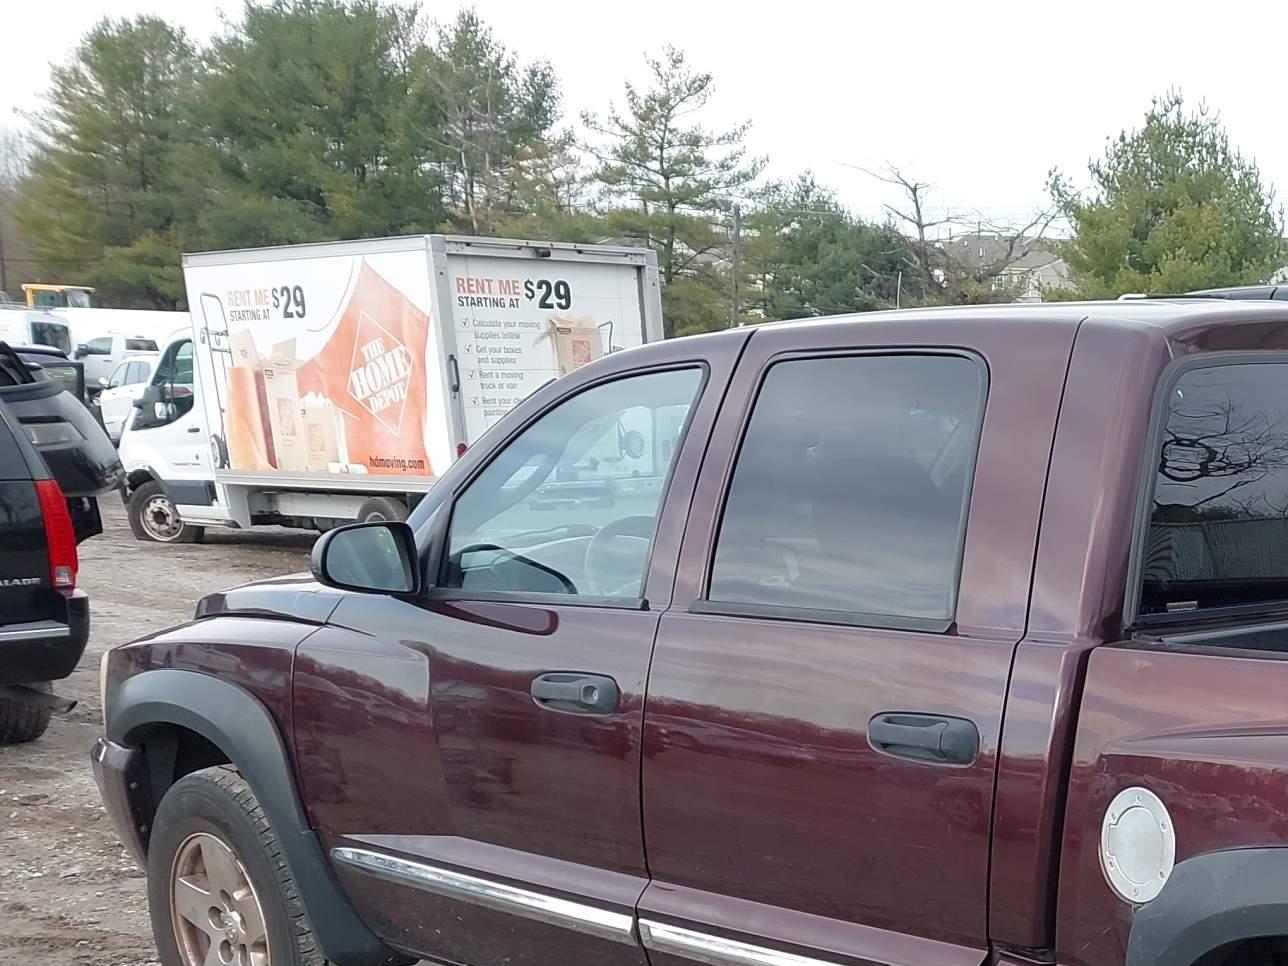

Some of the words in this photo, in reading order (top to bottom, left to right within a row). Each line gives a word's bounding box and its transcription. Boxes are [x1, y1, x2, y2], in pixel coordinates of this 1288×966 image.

[456, 277, 493, 295] RENT
[499, 279, 521, 296] ME
[524, 278, 571, 310] $29
[227, 290, 251, 306] RENT
[254, 289, 270, 305] ME
[271, 285, 306, 318] $29
[458, 296, 505, 309] STARTING
[509, 297, 520, 309] AT
[230, 309, 261, 322] STARTING
[263, 309, 270, 320] AT
[472, 319, 502, 328] Calculate
[503, 321, 517, 329] your
[518, 321, 541, 330] moving
[360, 337, 385, 361] THE
[489, 346, 502, 355] your
[351, 345, 410, 400] HOME
[479, 371, 494, 379] Rent
[501, 372, 524, 380] moving
[368, 380, 406, 414] DEPOT
[369, 456, 425, 471] hdmoving.com
